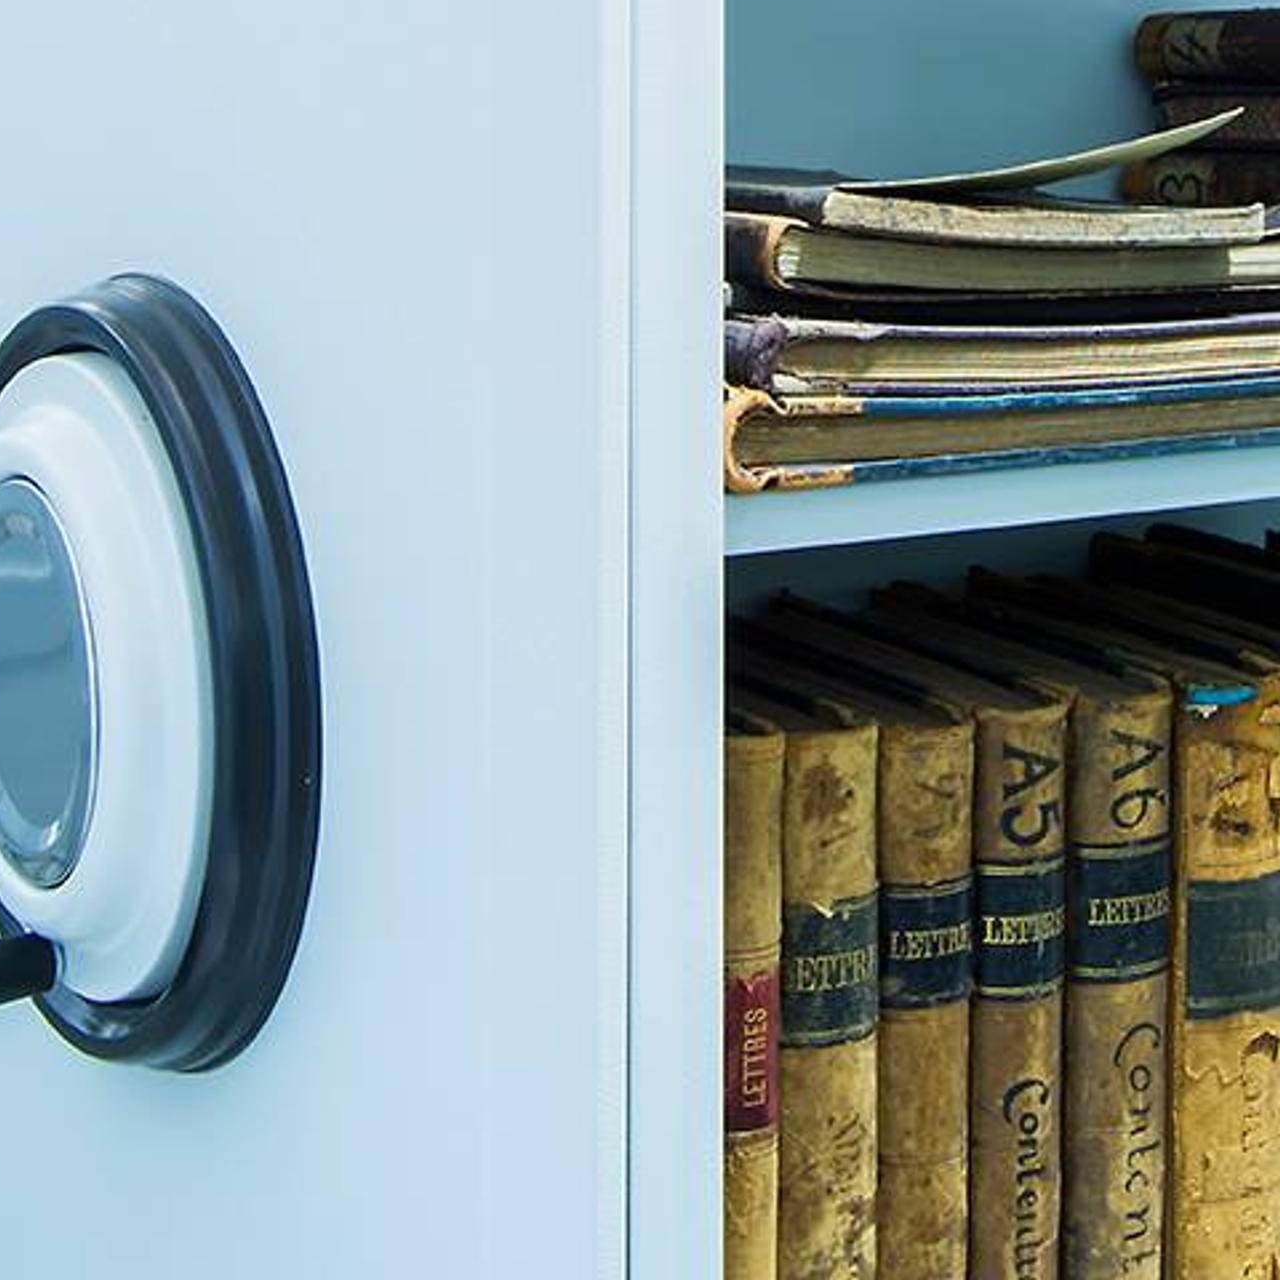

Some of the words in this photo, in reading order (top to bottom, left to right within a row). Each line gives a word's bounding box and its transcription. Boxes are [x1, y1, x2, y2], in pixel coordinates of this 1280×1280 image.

[1001, 744, 1062, 848] A5
[1109, 729, 1169, 829] A6
[743, 1006, 769, 1109] LETTRES
